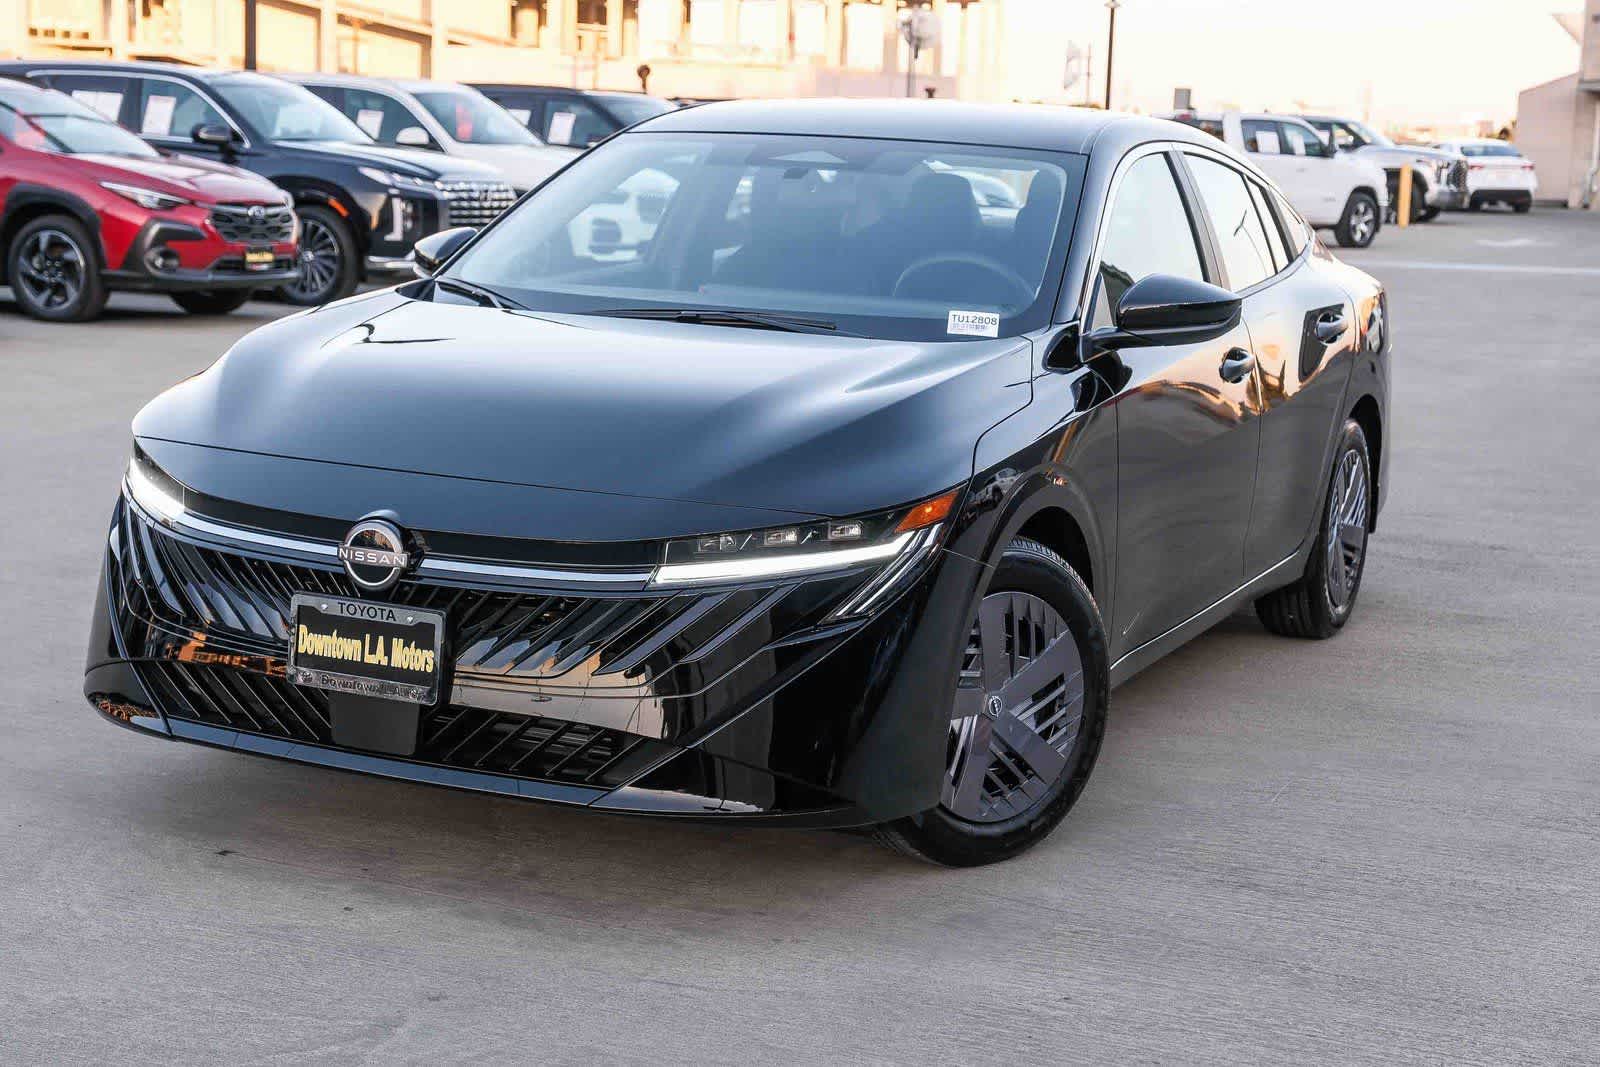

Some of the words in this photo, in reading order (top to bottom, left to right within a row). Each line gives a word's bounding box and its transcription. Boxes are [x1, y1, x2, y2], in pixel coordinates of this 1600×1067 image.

[952, 314, 997, 325] TU12808
[339, 547, 405, 565] NISSAN
[337, 602, 396, 621] TOYOTA
[298, 624, 362, 662] Downtown
[364, 633, 389, 666] L.A.
[391, 637, 434, 673] Motors
